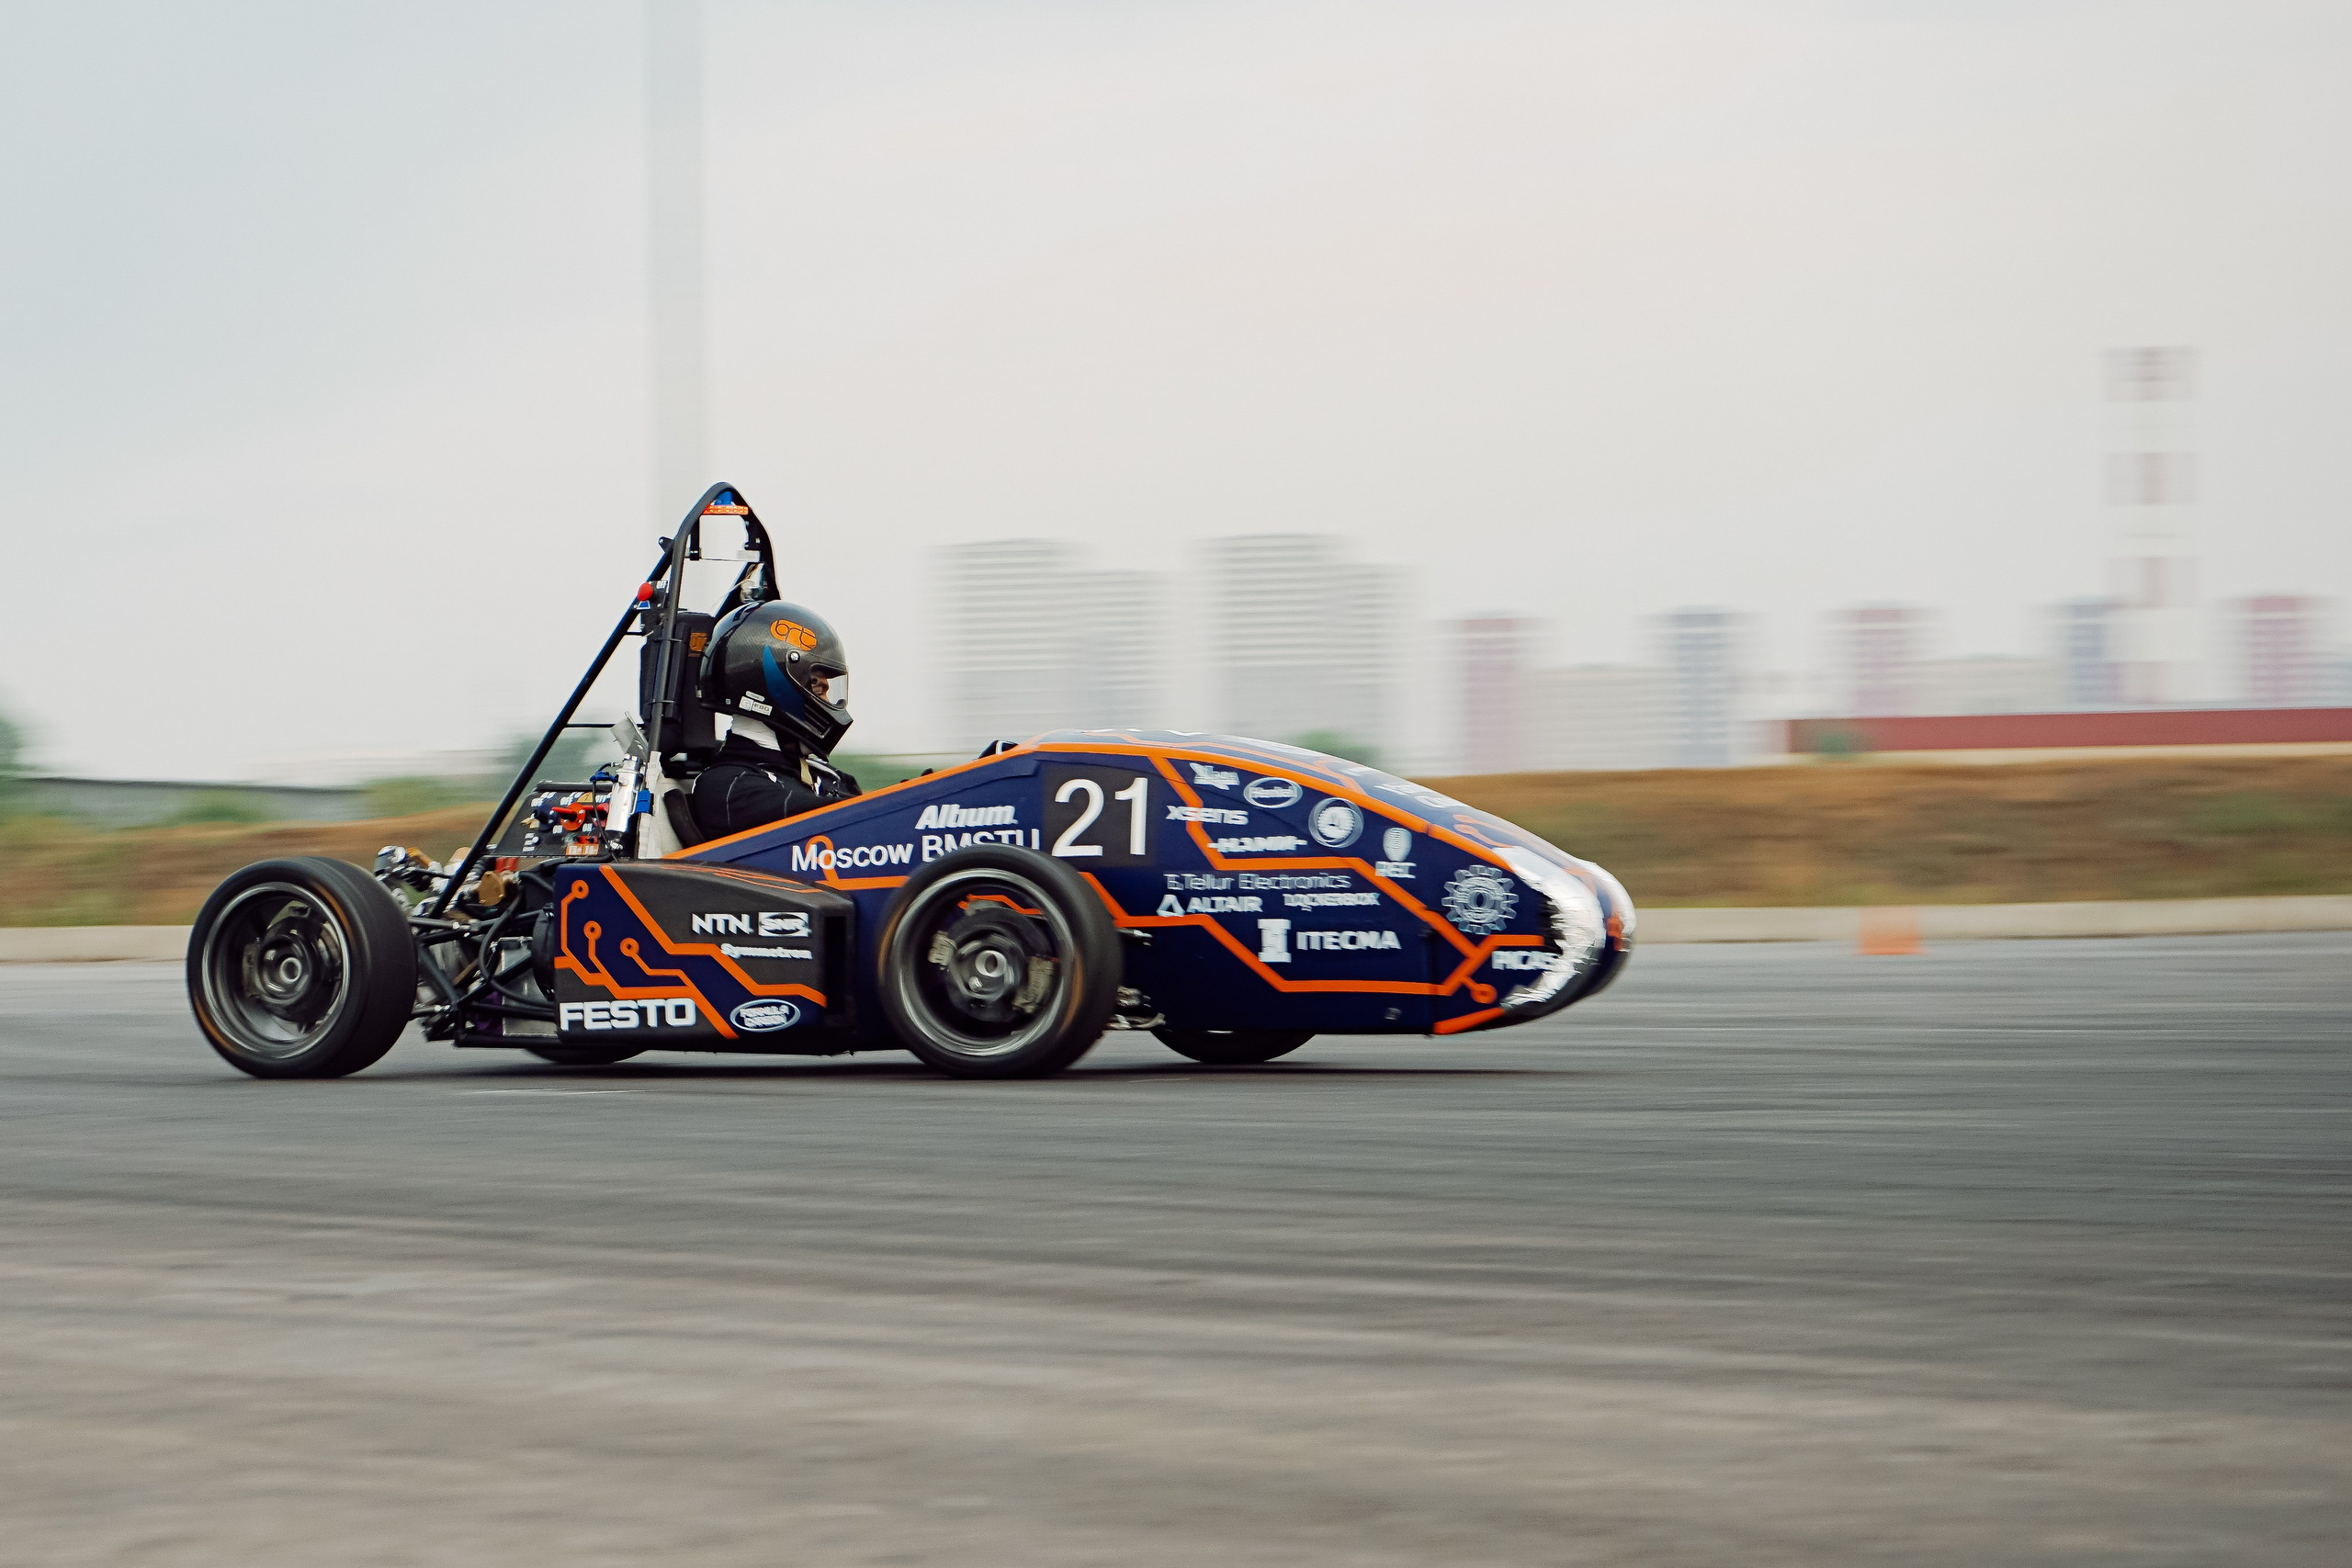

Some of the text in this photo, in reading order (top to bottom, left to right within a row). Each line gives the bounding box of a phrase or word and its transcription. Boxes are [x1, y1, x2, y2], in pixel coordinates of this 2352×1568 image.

[915, 804, 1017, 830] Altium
[1051, 777, 1148, 858] 21
[791, 842, 913, 873] Moscow
[692, 913, 751, 935] NTN
[559, 998, 696, 1032] FESTO
